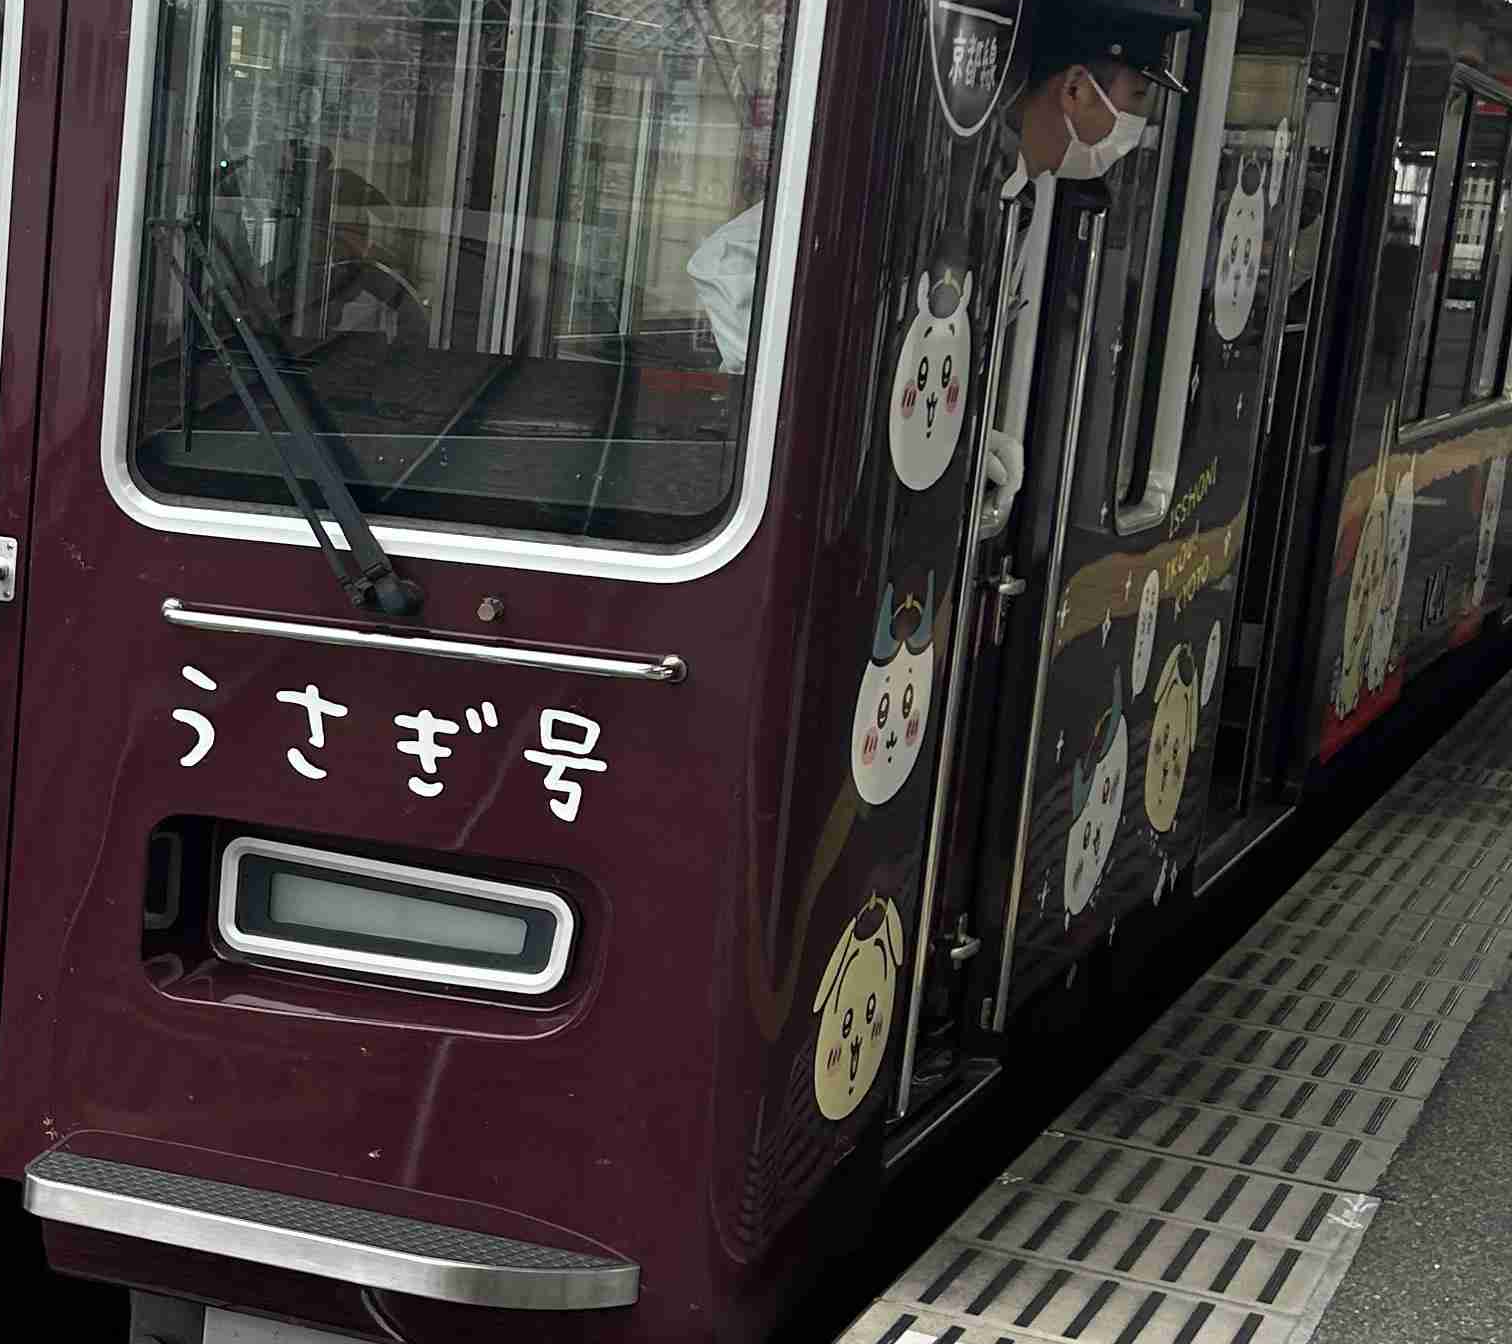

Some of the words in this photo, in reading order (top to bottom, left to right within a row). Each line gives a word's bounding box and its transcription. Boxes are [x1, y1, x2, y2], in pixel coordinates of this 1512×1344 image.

[948, 30, 997, 91] 京都線
[173, 666, 607, 821] うさぎ号
